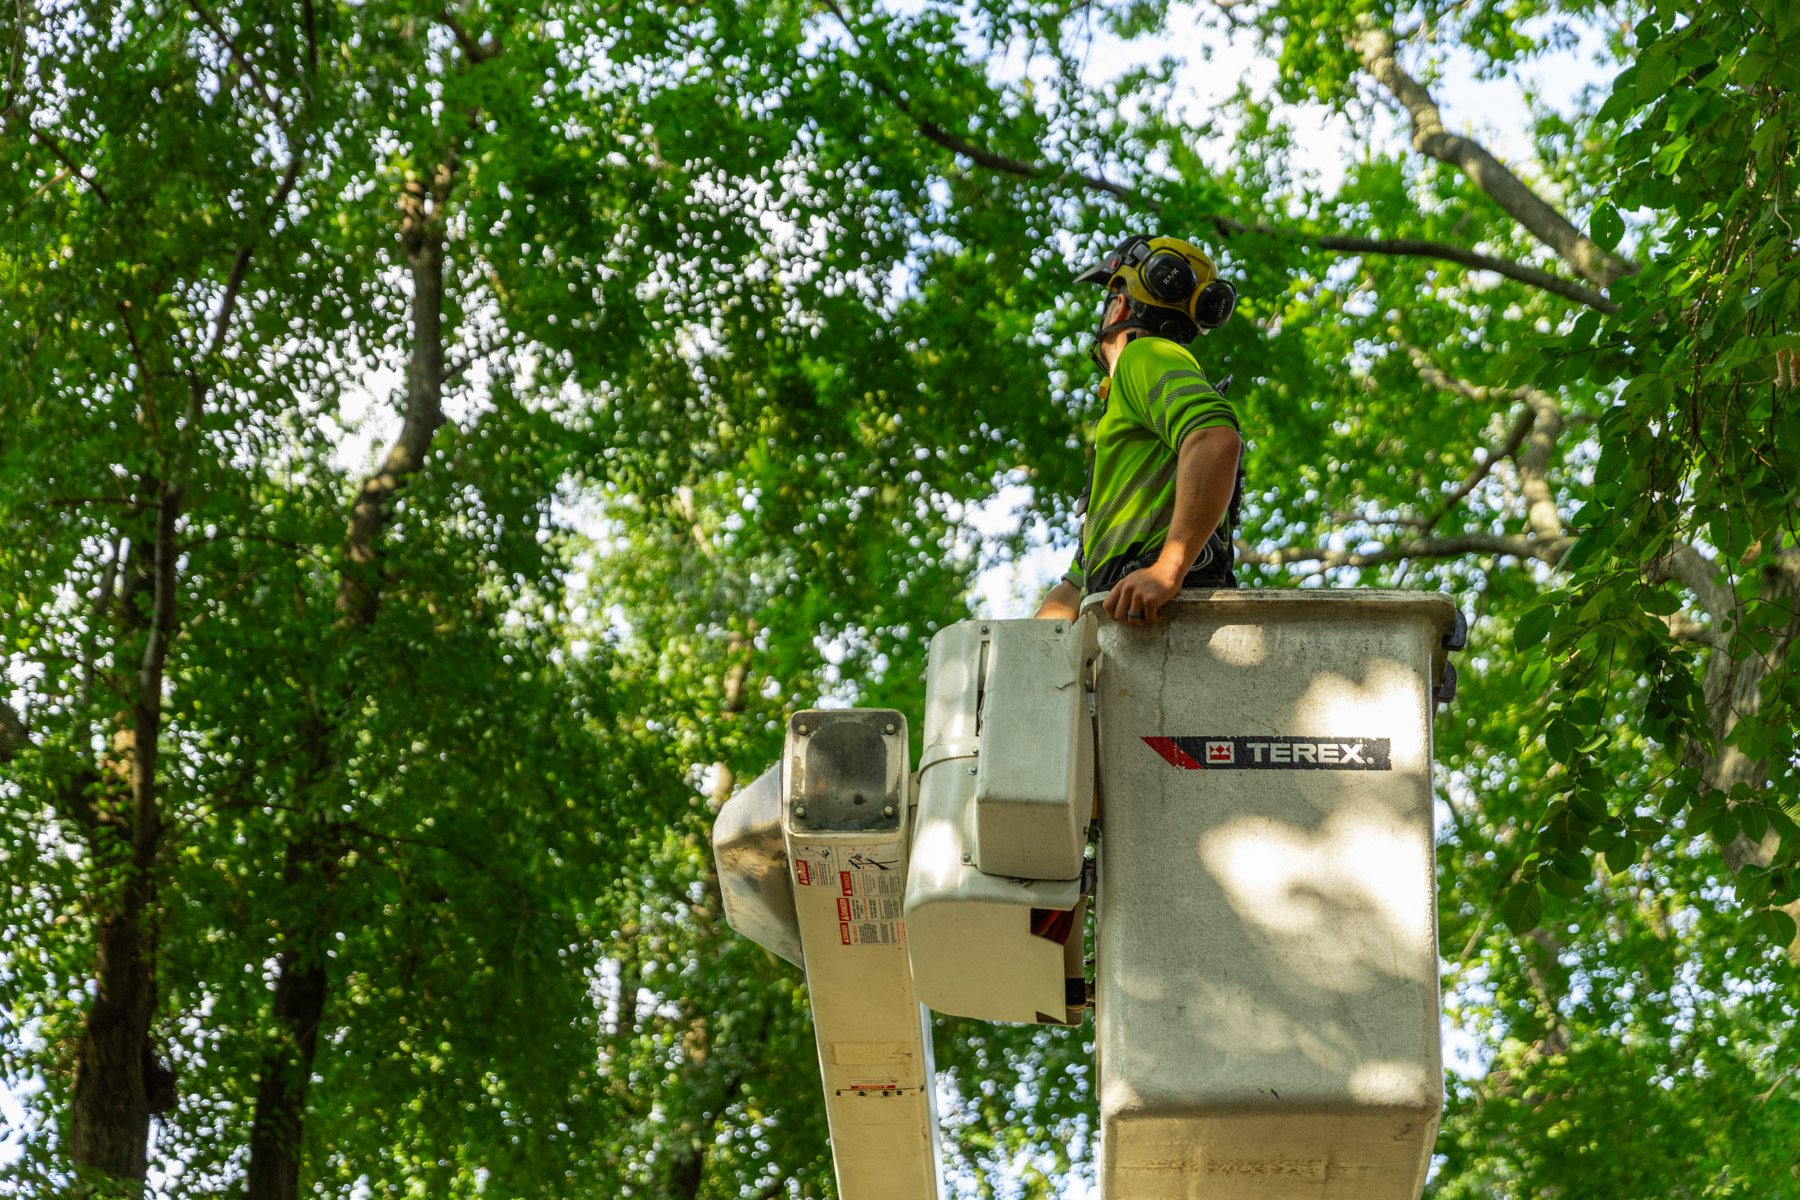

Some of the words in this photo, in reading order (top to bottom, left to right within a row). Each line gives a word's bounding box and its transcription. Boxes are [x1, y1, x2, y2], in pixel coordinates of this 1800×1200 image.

[798, 862, 807, 880] DANGER
[843, 873, 851, 886] DANGER
[840, 899, 850, 917] DANGER
[841, 925, 849, 939] DANGER
